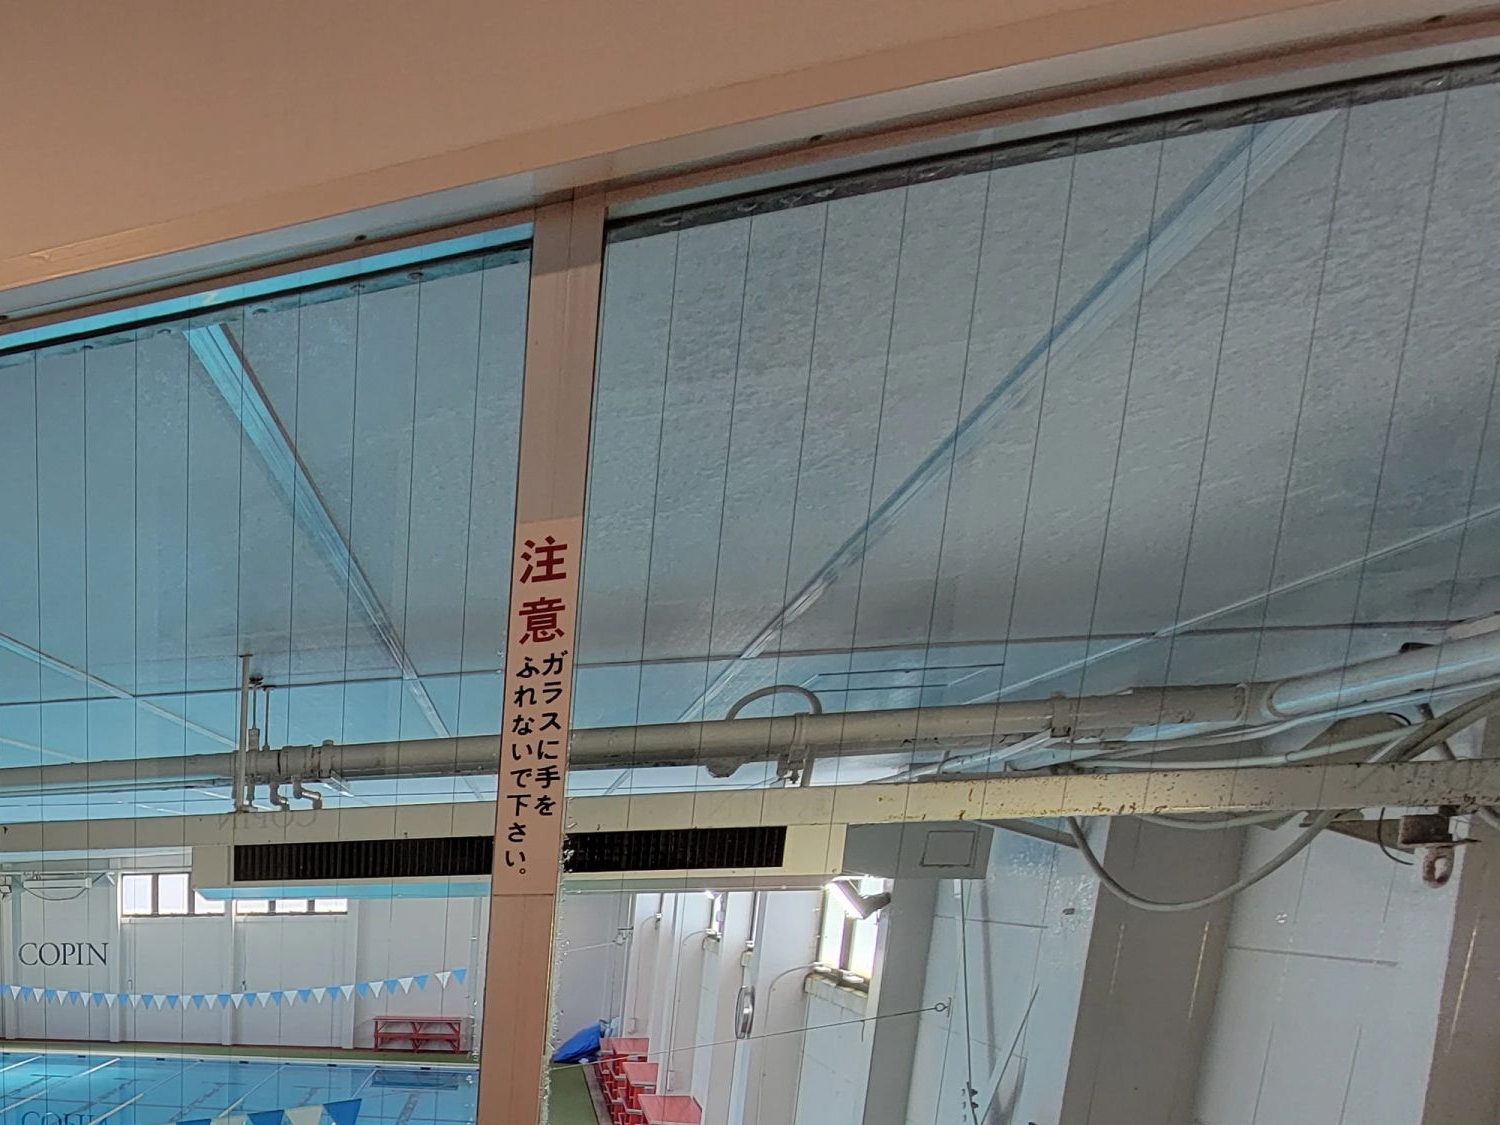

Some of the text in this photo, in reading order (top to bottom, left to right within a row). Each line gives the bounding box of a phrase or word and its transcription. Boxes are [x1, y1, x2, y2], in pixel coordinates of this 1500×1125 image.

[519, 535, 568, 645] 注意
[505, 656, 540, 875] ふれないで下さい。
[534, 650, 569, 816] ガラスに手を
[18, 942, 109, 967] COPIN
